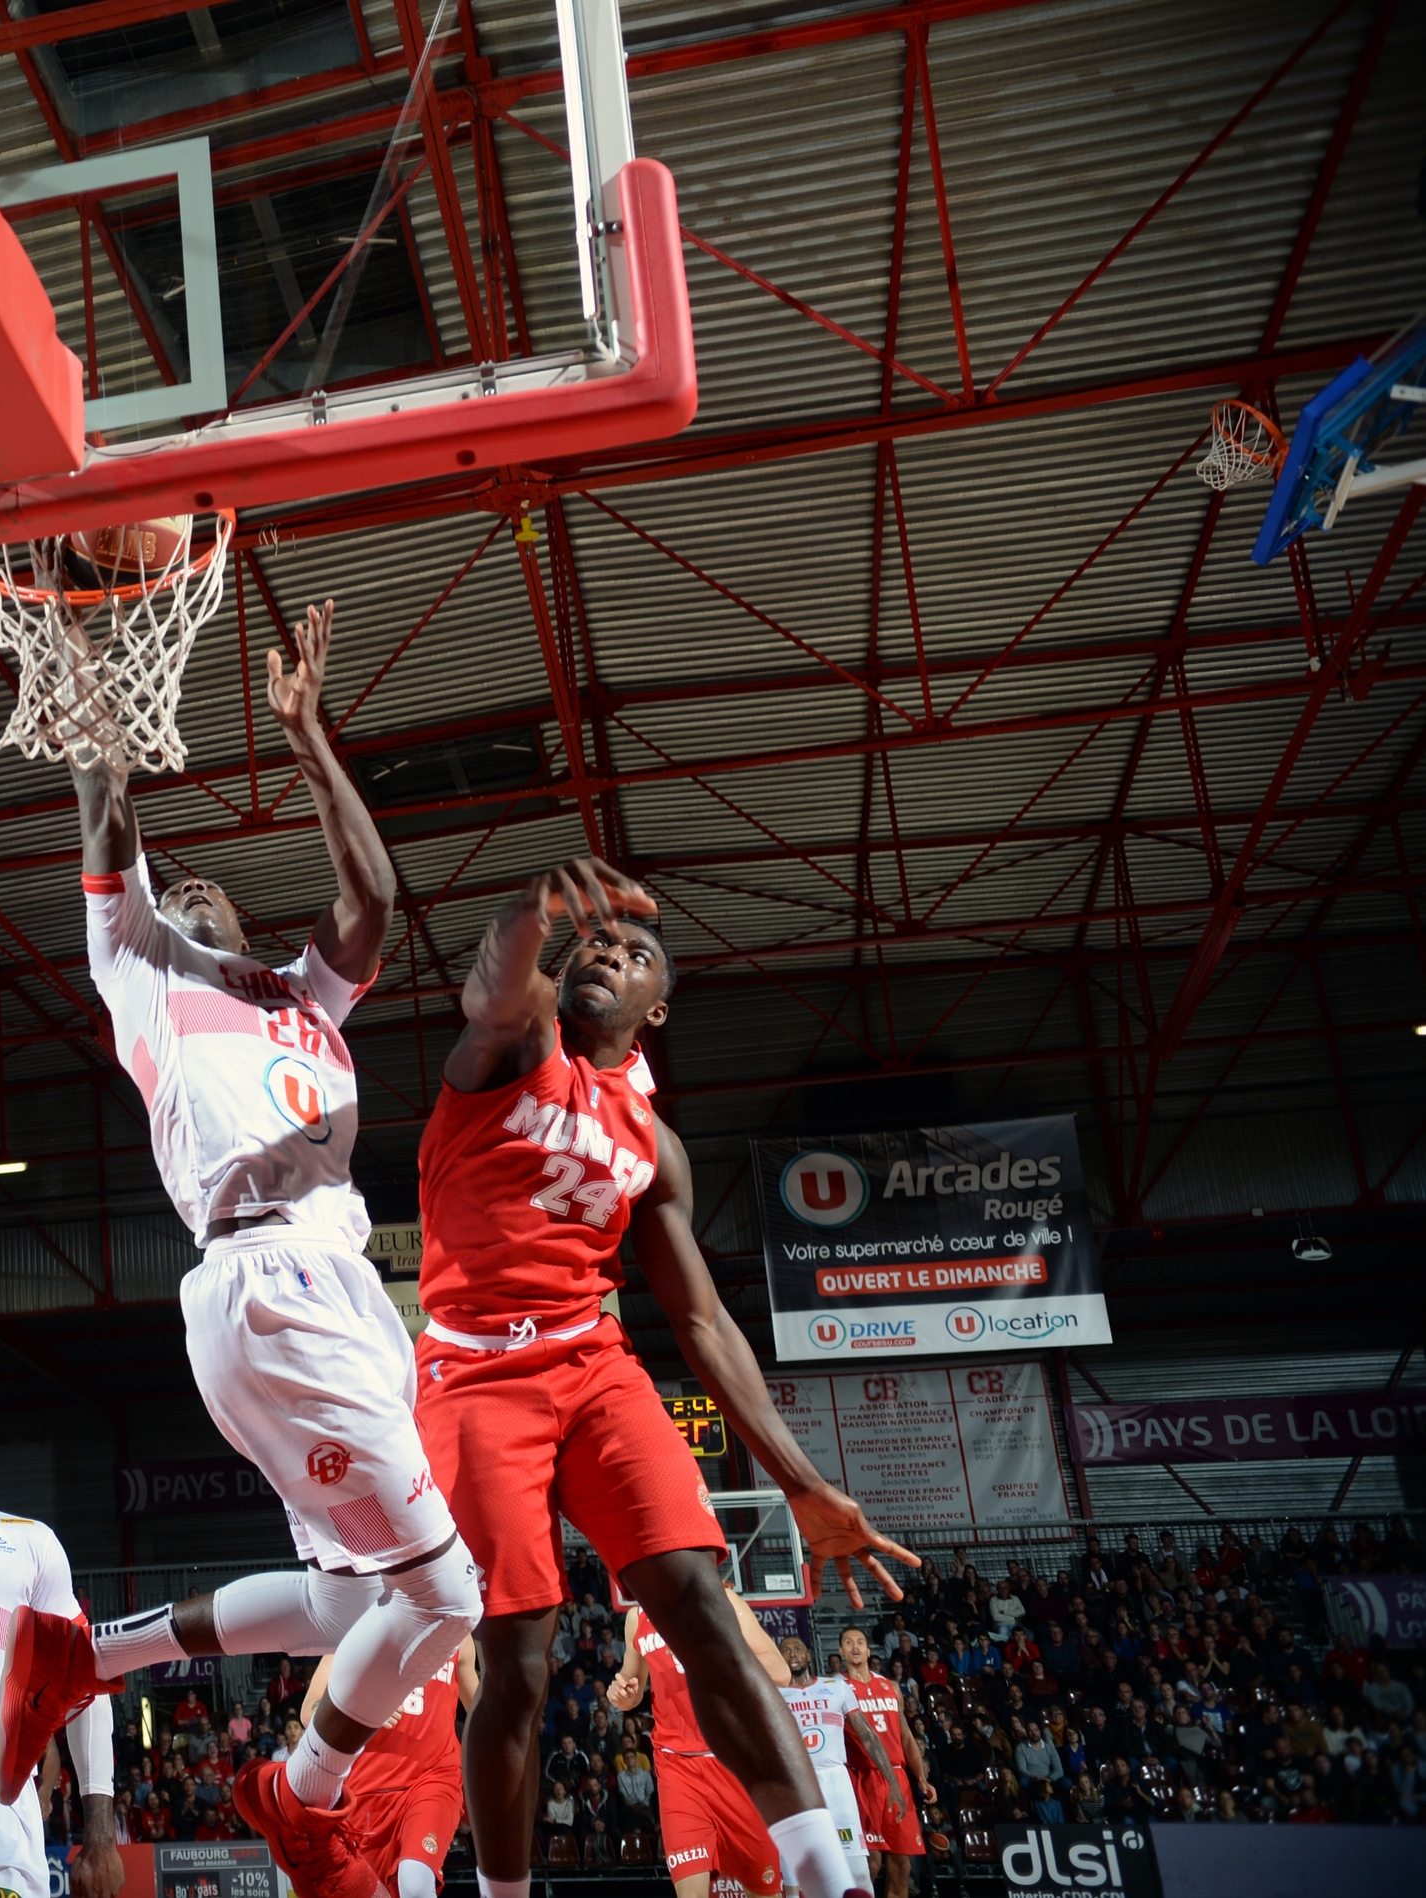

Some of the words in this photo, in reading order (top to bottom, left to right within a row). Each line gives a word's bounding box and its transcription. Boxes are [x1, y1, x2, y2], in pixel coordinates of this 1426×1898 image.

[267, 1006, 320, 1058] 26
[284, 1074, 321, 1126] U
[883, 1151, 1062, 1199] Arcades
[530, 1153, 622, 1228] 24
[800, 1171, 847, 1211] U
[984, 1193, 1063, 1221] Rougé
[783, 1243, 830, 1260] Votre
[835, 1234, 944, 1261] supermarché
[1004, 1229, 1026, 1247] de
[1032, 1228, 1062, 1245] ville
[823, 1271, 901, 1292] OUVERT
[908, 1269, 930, 1287] LE
[935, 1262, 1042, 1286] DIMANCHE
[851, 1320, 915, 1337] DRIVE
[989, 1312, 1078, 1332] location
[853, 1337, 913, 1348] coursesu.com
[967, 1369, 1004, 1395] CB
[863, 1377, 898, 1402] CB
[859, 1401, 928, 1411] ASSOCIATION
[977, 1395, 1019, 1404] CADETS
[843, 1411, 894, 1421] CHAMPION
[911, 1409, 948, 1417] FRANCE
[969, 1408, 1021, 1417] CHAMPION
[840, 1420, 888, 1428] MASCULIN
[890, 1417, 945, 1426] NATIONALE
[985, 1416, 1023, 1424] FRANCE
[1119, 1416, 1213, 1448] PAYS
[1223, 1413, 1276, 1445] DE
[1286, 1410, 1339, 1441] LA
[847, 1438, 898, 1447] CHAMPION
[915, 1435, 952, 1443] FRANCE
[893, 1443, 949, 1452] NATIONALE
[909, 1461, 946, 1469] FRANCE
[881, 1470, 928, 1478] CADETTES
[153, 1471, 227, 1502] PAYS
[855, 1489, 906, 1497] CHAMPION
[923, 1486, 961, 1494] FRANCE
[992, 1483, 1024, 1492] COUPE
[1027, 1482, 1039, 1490] DE
[865, 1496, 905, 1504] MINIMES
[908, 1494, 953, 1503] GARÇONS
[998, 1490, 1036, 1499] FRANCE
[928, 1512, 965, 1520] FRANCE
[1003, 1507, 1037, 1515] SAISONS
[859, 1698, 898, 1713] ONACO
[800, 1713, 818, 1727] 21
[872, 1713, 887, 1732] 3
[171, 1849, 229, 1860] FAUBOURG
[1002, 1830, 1123, 1887] dlsi
[232, 1872, 269, 1888] -10%
[231, 1886, 244, 1896] les
[247, 1886, 270, 1897] soirs
